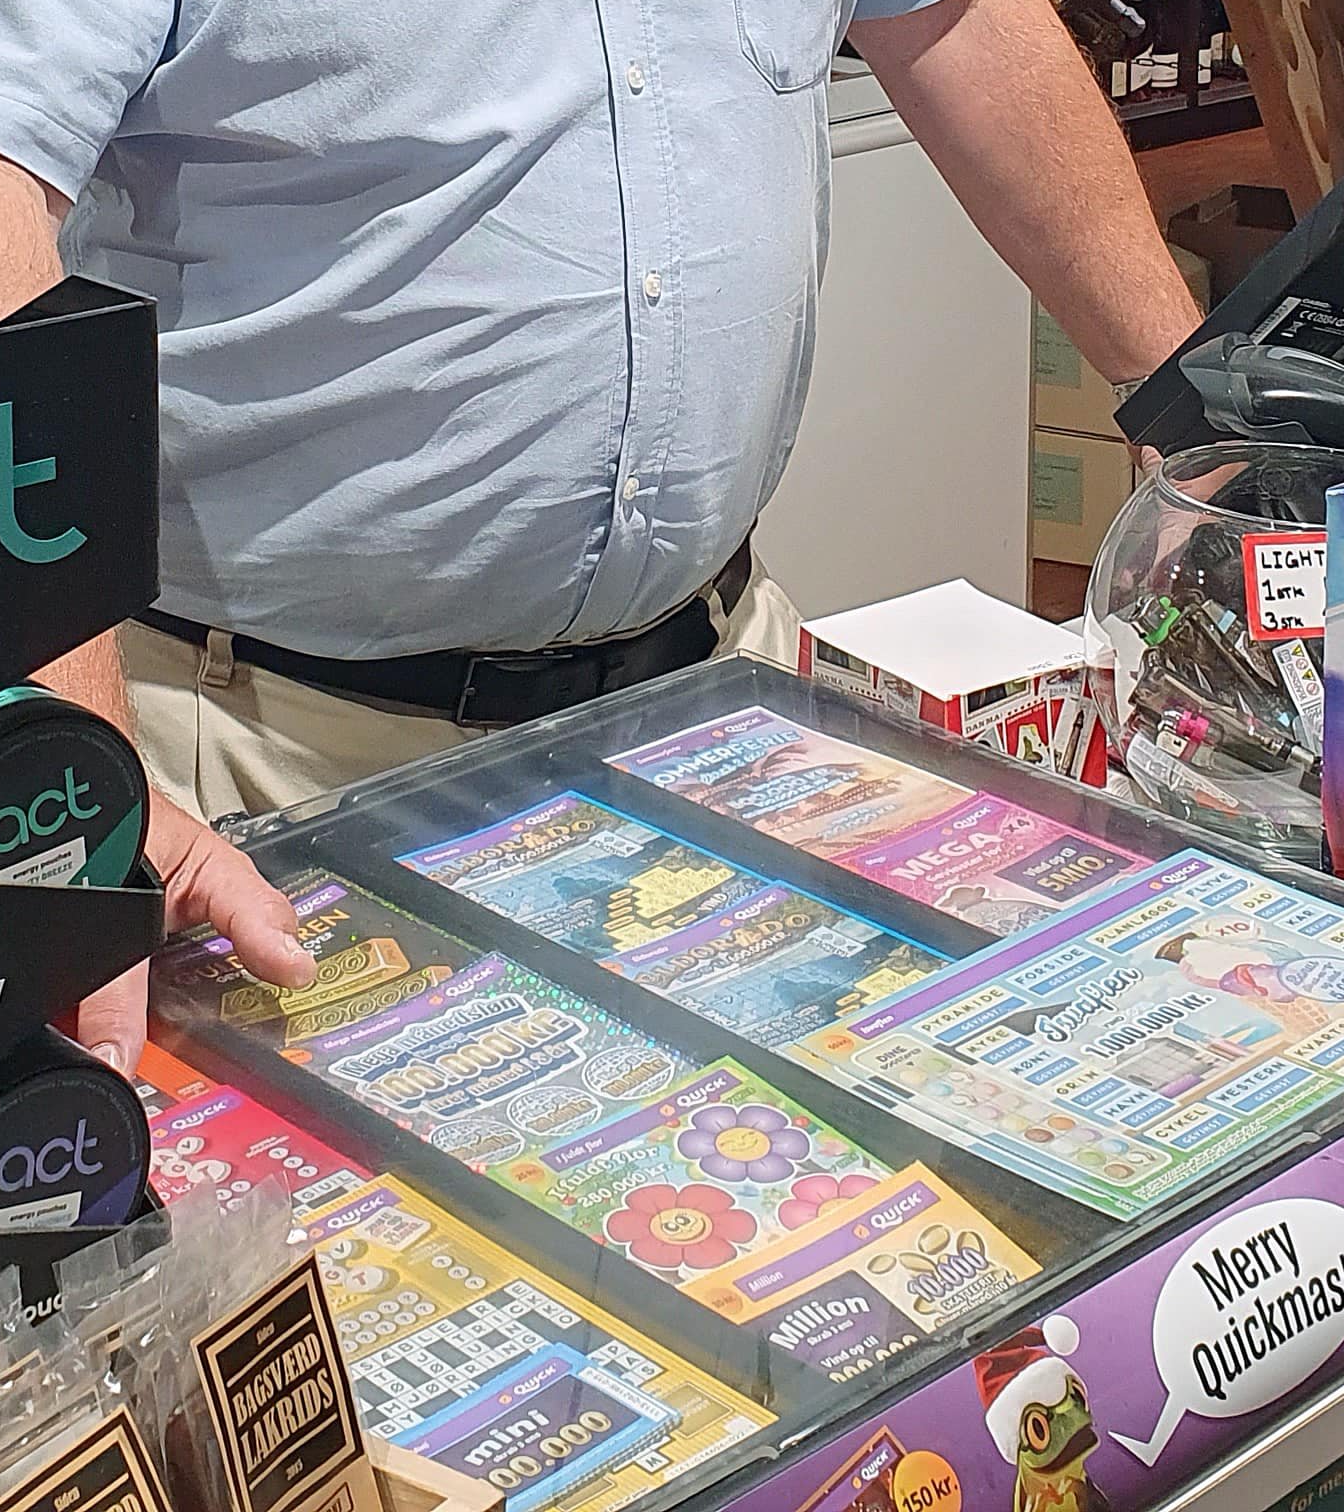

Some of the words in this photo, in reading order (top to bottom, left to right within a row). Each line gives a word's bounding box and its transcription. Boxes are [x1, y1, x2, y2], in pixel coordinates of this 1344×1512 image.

[725, 716, 762, 737] QUICK
[653, 728, 800, 789] OMMERFERIE
[524, 802, 568, 827] QUICK
[953, 806, 991, 831] QUICK
[891, 831, 1005, 882] MEGA
[1162, 862, 1200, 884] QUICK
[1185, 872, 1234, 899] FLYVE
[1243, 892, 1273, 909] DAD
[735, 893, 777, 922] QUICK
[1287, 910, 1314, 927] KAR
[1014, 948, 1084, 985] FORSIDE
[445, 966, 494, 1001] QUICK
[921, 989, 1004, 1032] PYRAMIDE
[1083, 996, 1186, 1060] 1.000.000
[1184, 992, 1214, 1016] kr.
[967, 1030, 1010, 1054] MYRE
[1010, 1051, 1053, 1075] MØNT
[677, 1074, 727, 1107] QUICK
[1056, 1070, 1099, 1096] GRIN
[1216, 1060, 1287, 1103] WESTERN
[171, 1100, 228, 1130] QUICK
[1103, 1090, 1149, 1117] HAVN
[1155, 1109, 1209, 1139] CYKEL
[327, 1195, 384, 1228] QUICK
[870, 1191, 922, 1230] QUICK
[748, 1269, 783, 1292] Million
[1194, 1220, 1301, 1313] Merry
[769, 1295, 871, 1352] Million
[231, 1332, 321, 1429] BAGSVÆRD
[514, 1364, 556, 1395] QUICK
[240, 1368, 334, 1474] LAKRIDS
[463, 1410, 550, 1468] mini
[861, 1448, 889, 1481] QUICK
[902, 1483, 932, 1512] 150
[934, 1475, 959, 1501] kr.
